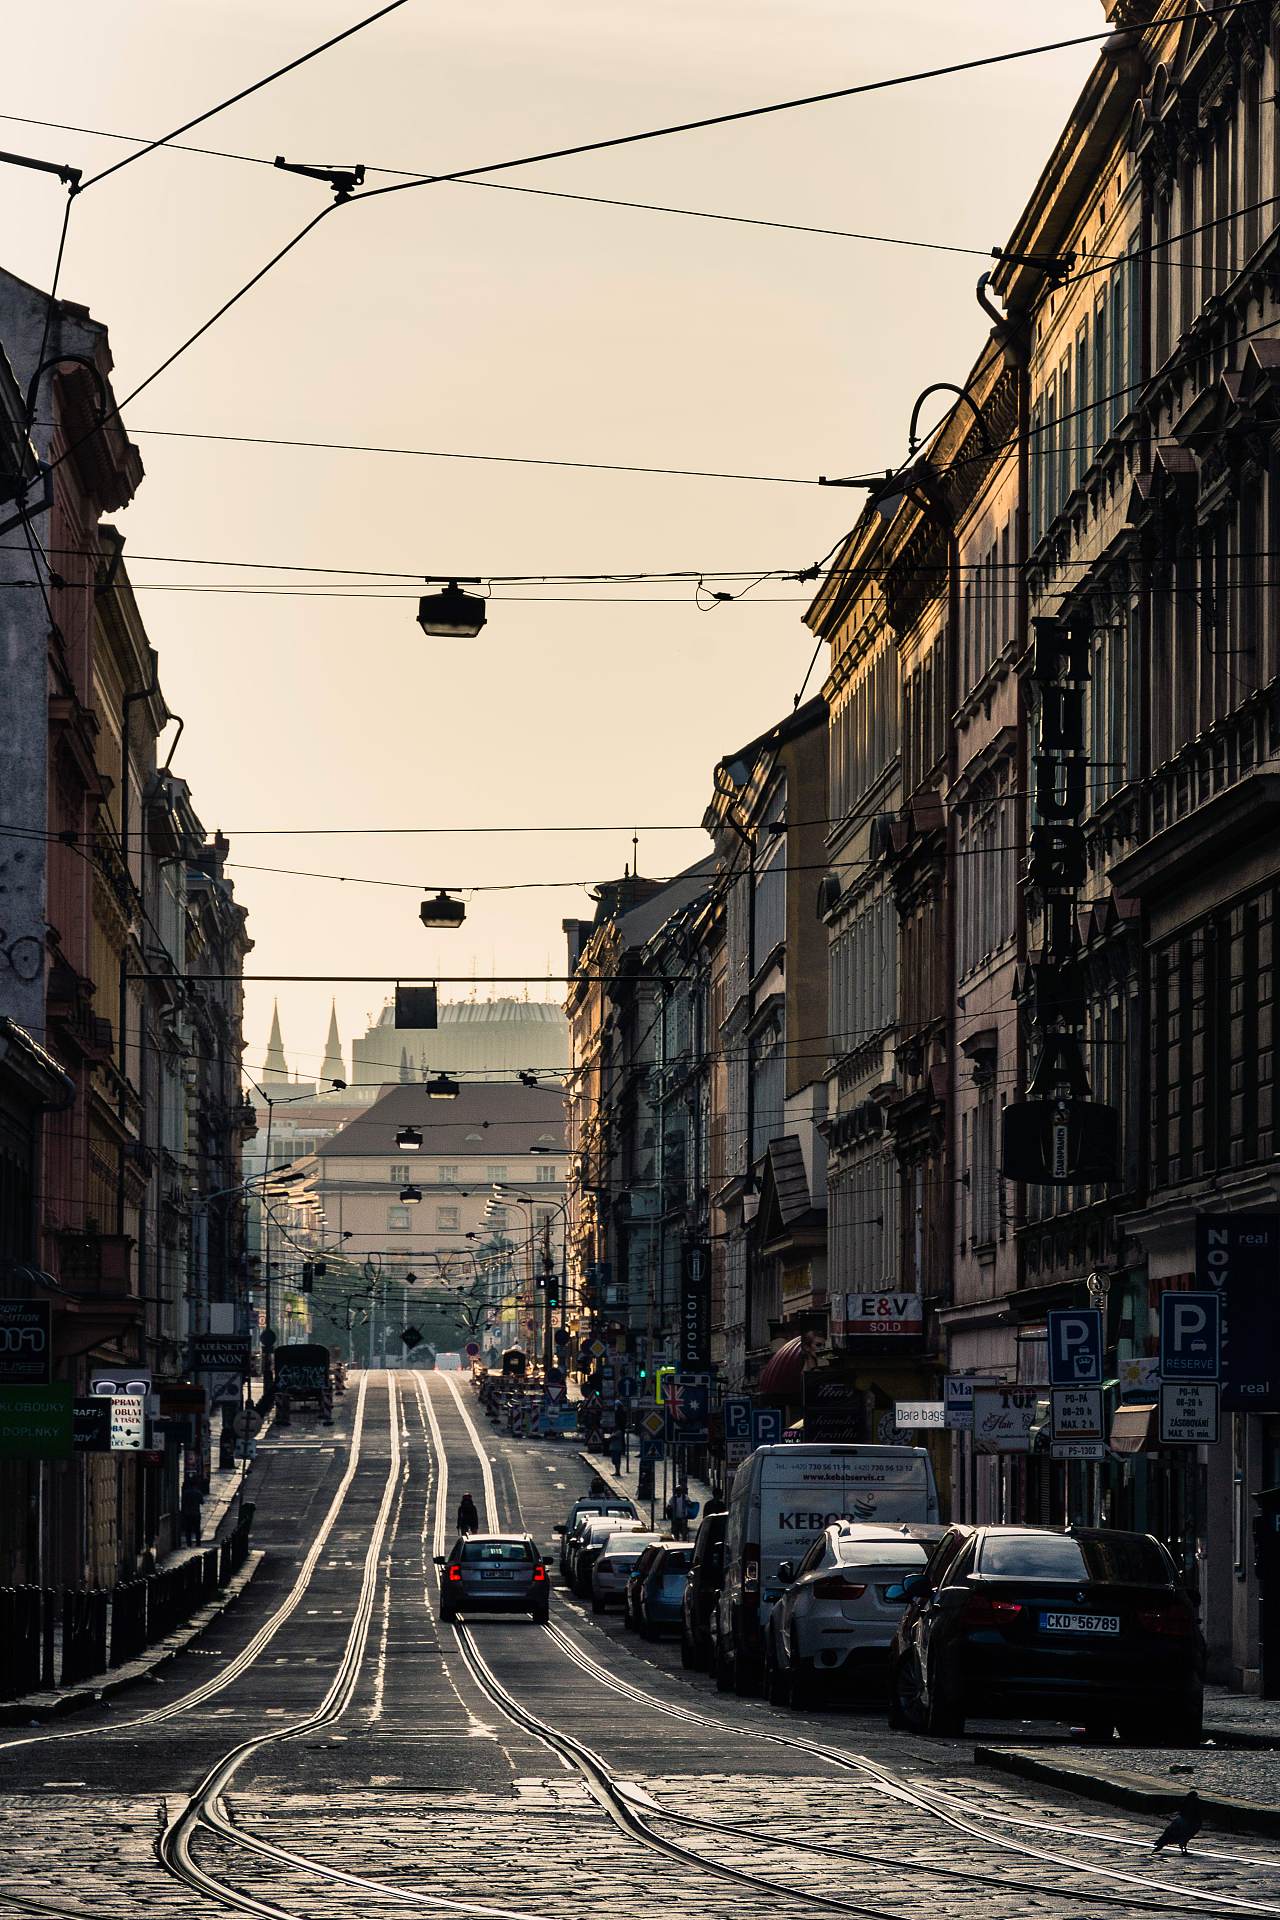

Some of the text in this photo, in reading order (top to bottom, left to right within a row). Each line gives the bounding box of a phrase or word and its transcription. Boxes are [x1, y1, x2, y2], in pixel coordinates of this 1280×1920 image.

[1238, 1231, 1269, 1244] real
[686, 1293, 699, 1360] prostor
[870, 1322, 901, 1332] SOLD
[1174, 1304, 1207, 1351] P
[1060, 1319, 1090, 1361] P
[200, 1353, 243, 1364] MANON
[1240, 1380, 1271, 1393] real
[1064, 1392, 1088, 1403] PO-PÁ
[730, 1405, 746, 1428] P
[897, 1409, 919, 1421] Dara
[921, 1409, 945, 1422] bags
[758, 1415, 775, 1439] P
